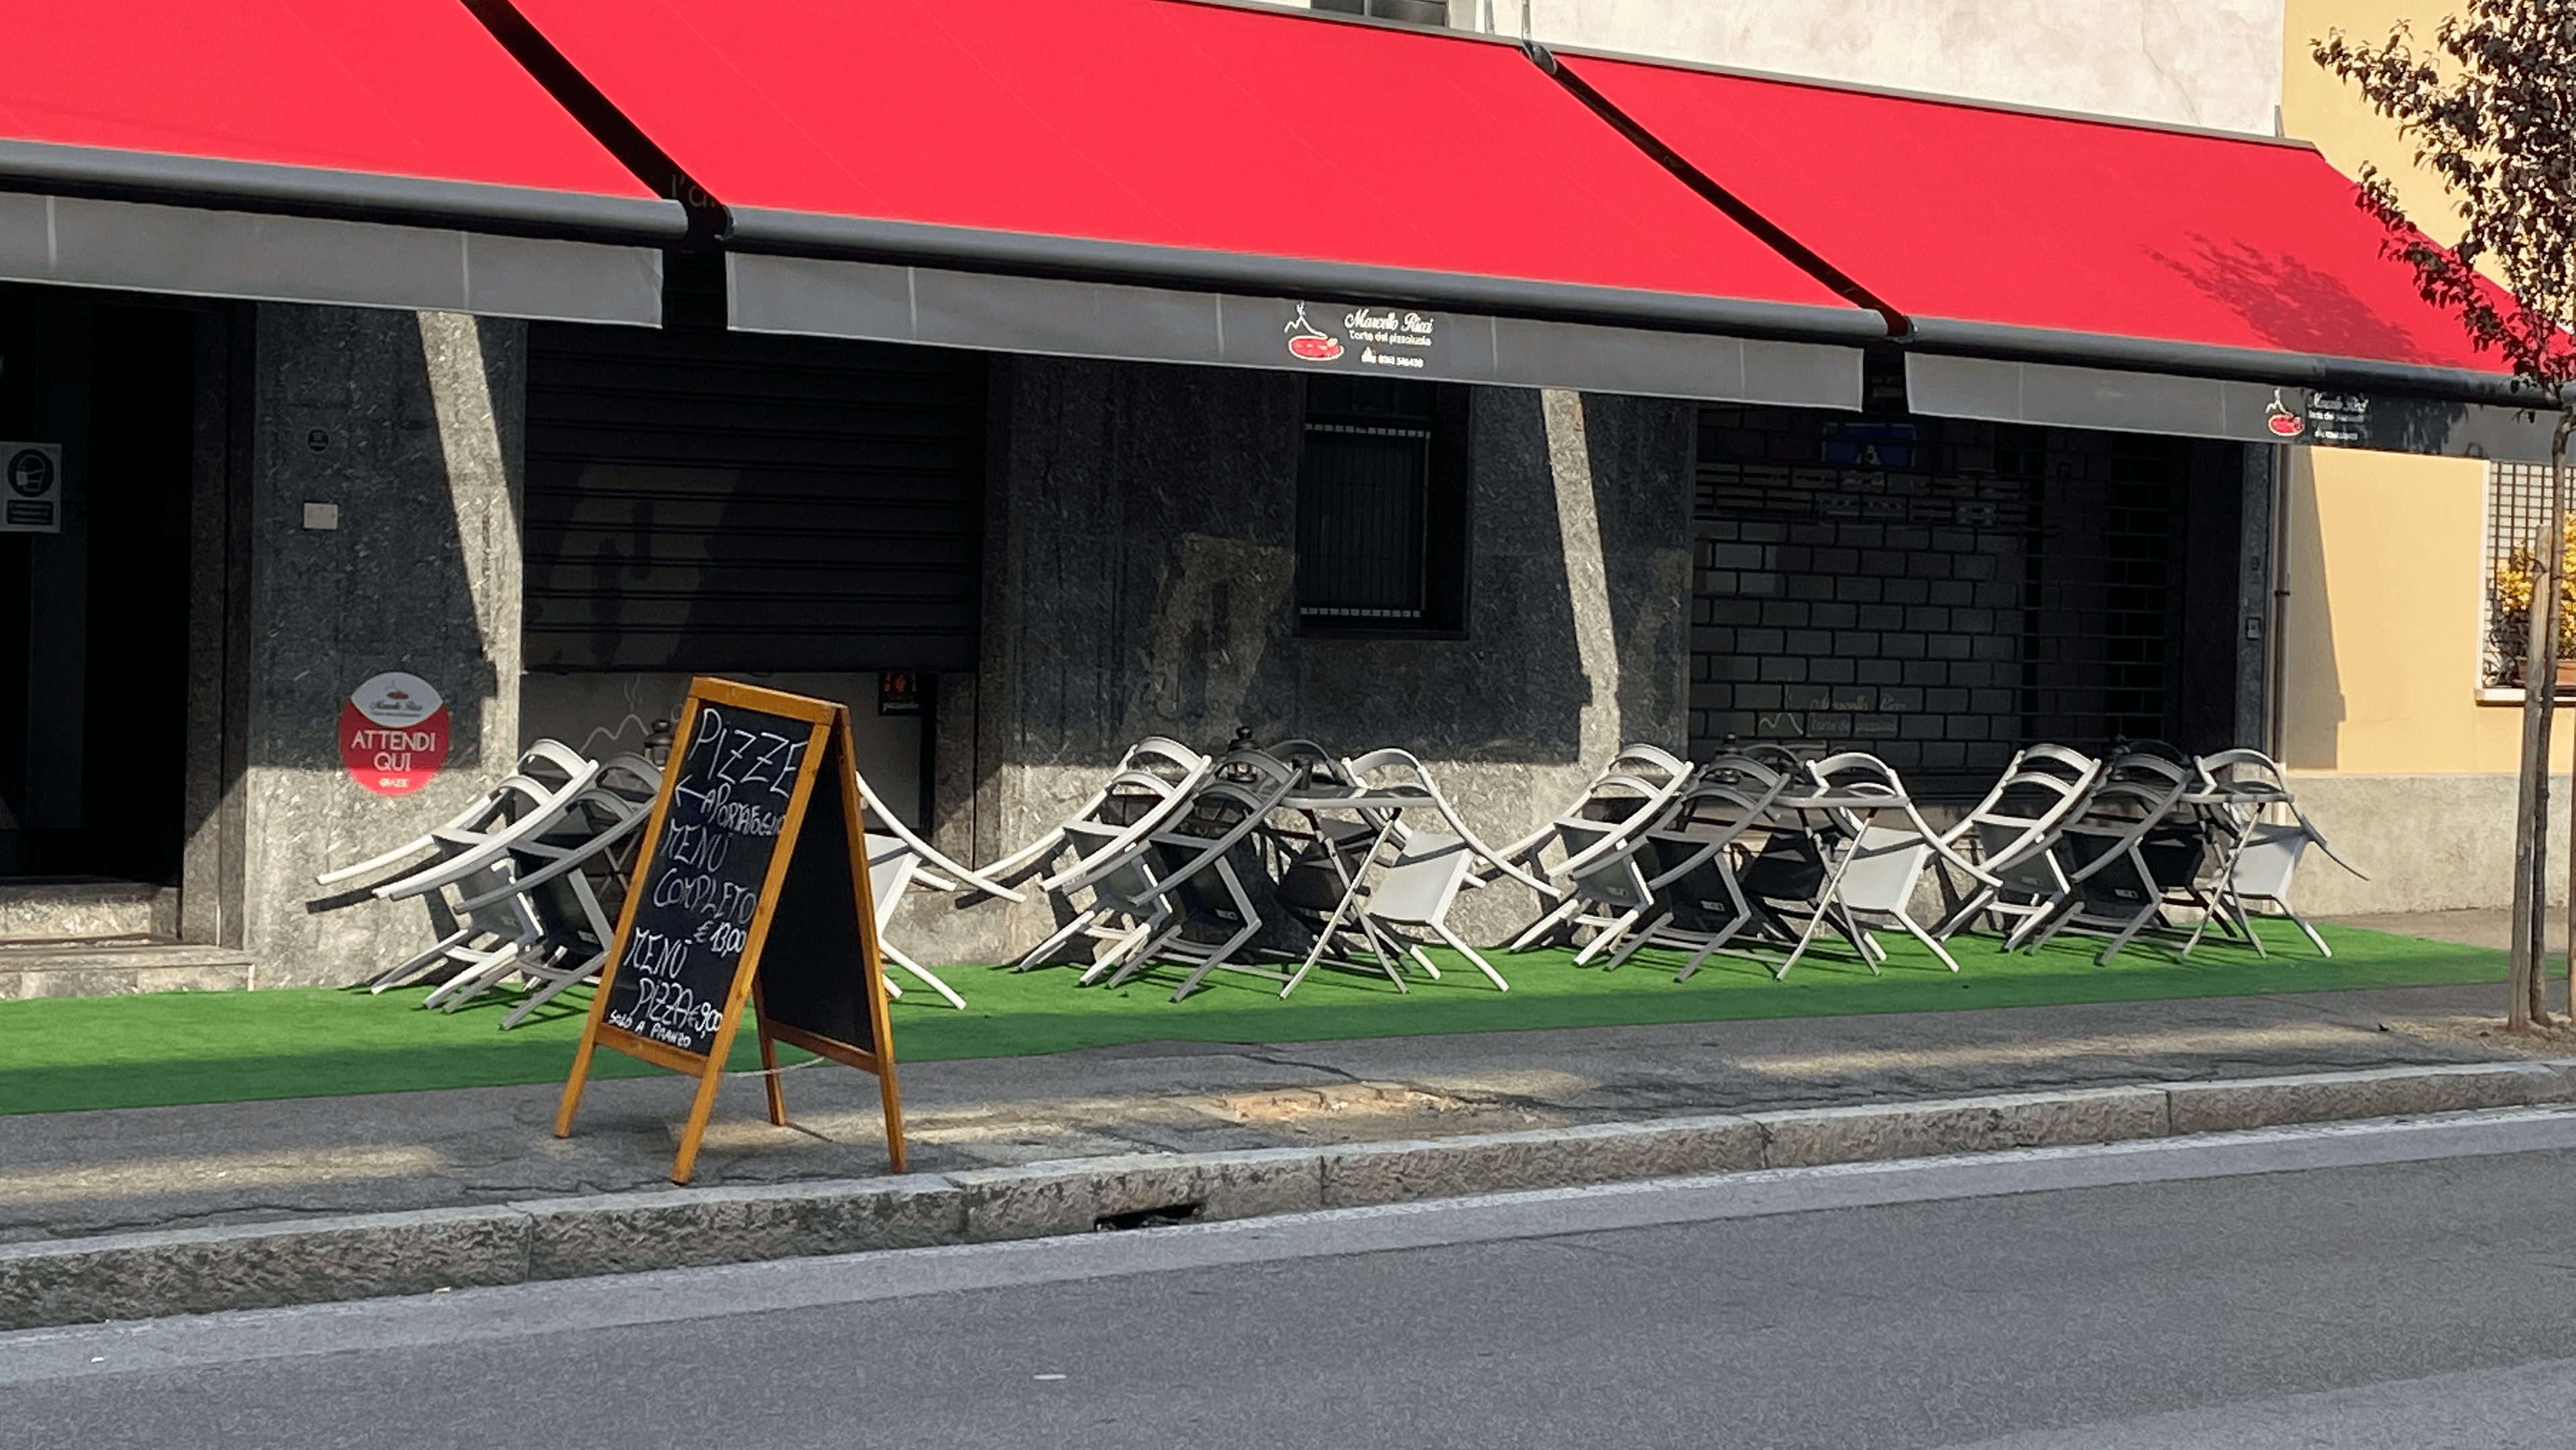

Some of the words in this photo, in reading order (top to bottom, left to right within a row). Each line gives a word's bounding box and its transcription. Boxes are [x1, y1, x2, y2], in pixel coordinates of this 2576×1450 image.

[351, 729, 436, 752] ATTENDI
[374, 752, 412, 772] QUI
[688, 708, 809, 798] PIZZE
[653, 868, 757, 924] COMPLETO
[635, 1021, 646, 1034] A
